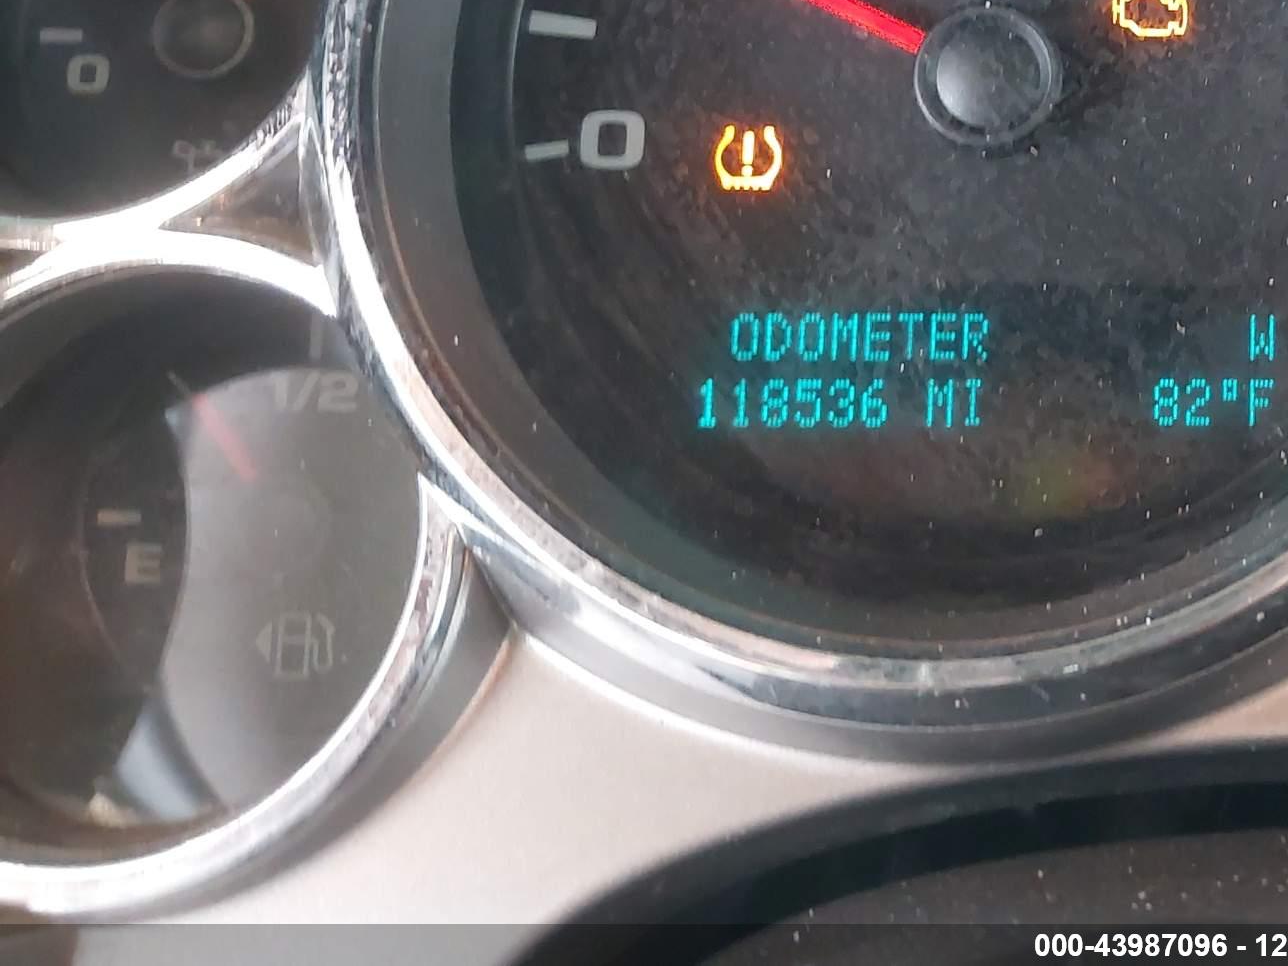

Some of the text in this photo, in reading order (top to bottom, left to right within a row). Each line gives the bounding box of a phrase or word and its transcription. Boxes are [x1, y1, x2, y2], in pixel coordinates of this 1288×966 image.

[67, 54, 109, 94] 0
[580, 110, 646, 170] 0
[731, 312, 989, 361] ODOMETER
[1249, 314, 1275, 361] W
[271, 371, 359, 413] 1/2
[697, 378, 982, 429] 118536 MI
[124, 543, 161, 583] E
